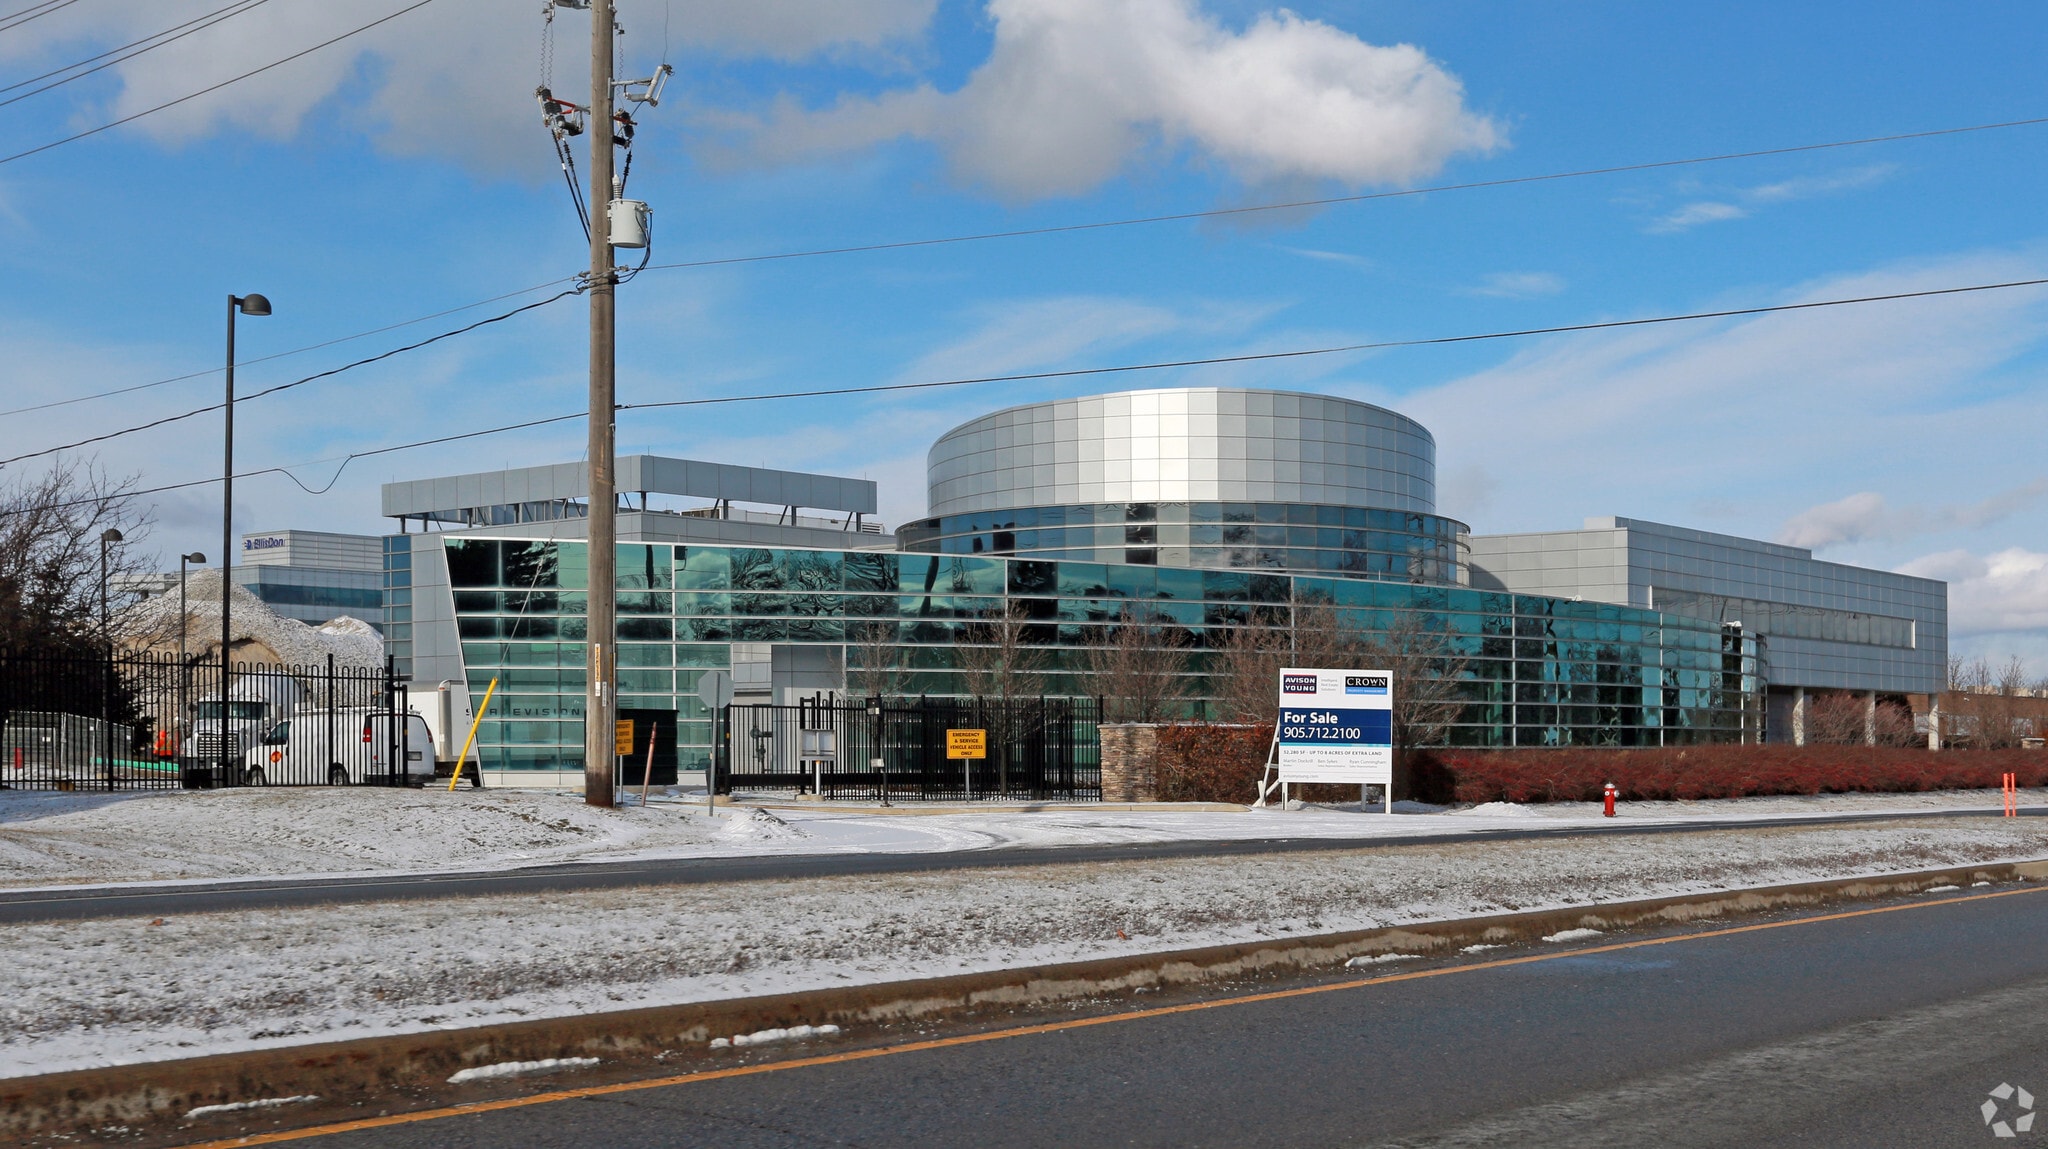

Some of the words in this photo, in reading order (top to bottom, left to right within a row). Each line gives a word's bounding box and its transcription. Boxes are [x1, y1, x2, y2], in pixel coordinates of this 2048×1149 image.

[254, 537, 284, 549] EllisDon
[1346, 677, 1386, 686] CROWN
[1284, 711, 1306, 723] For
[1310, 711, 1338, 724] Sale
[1284, 726, 1360, 739] 905.712.2100
